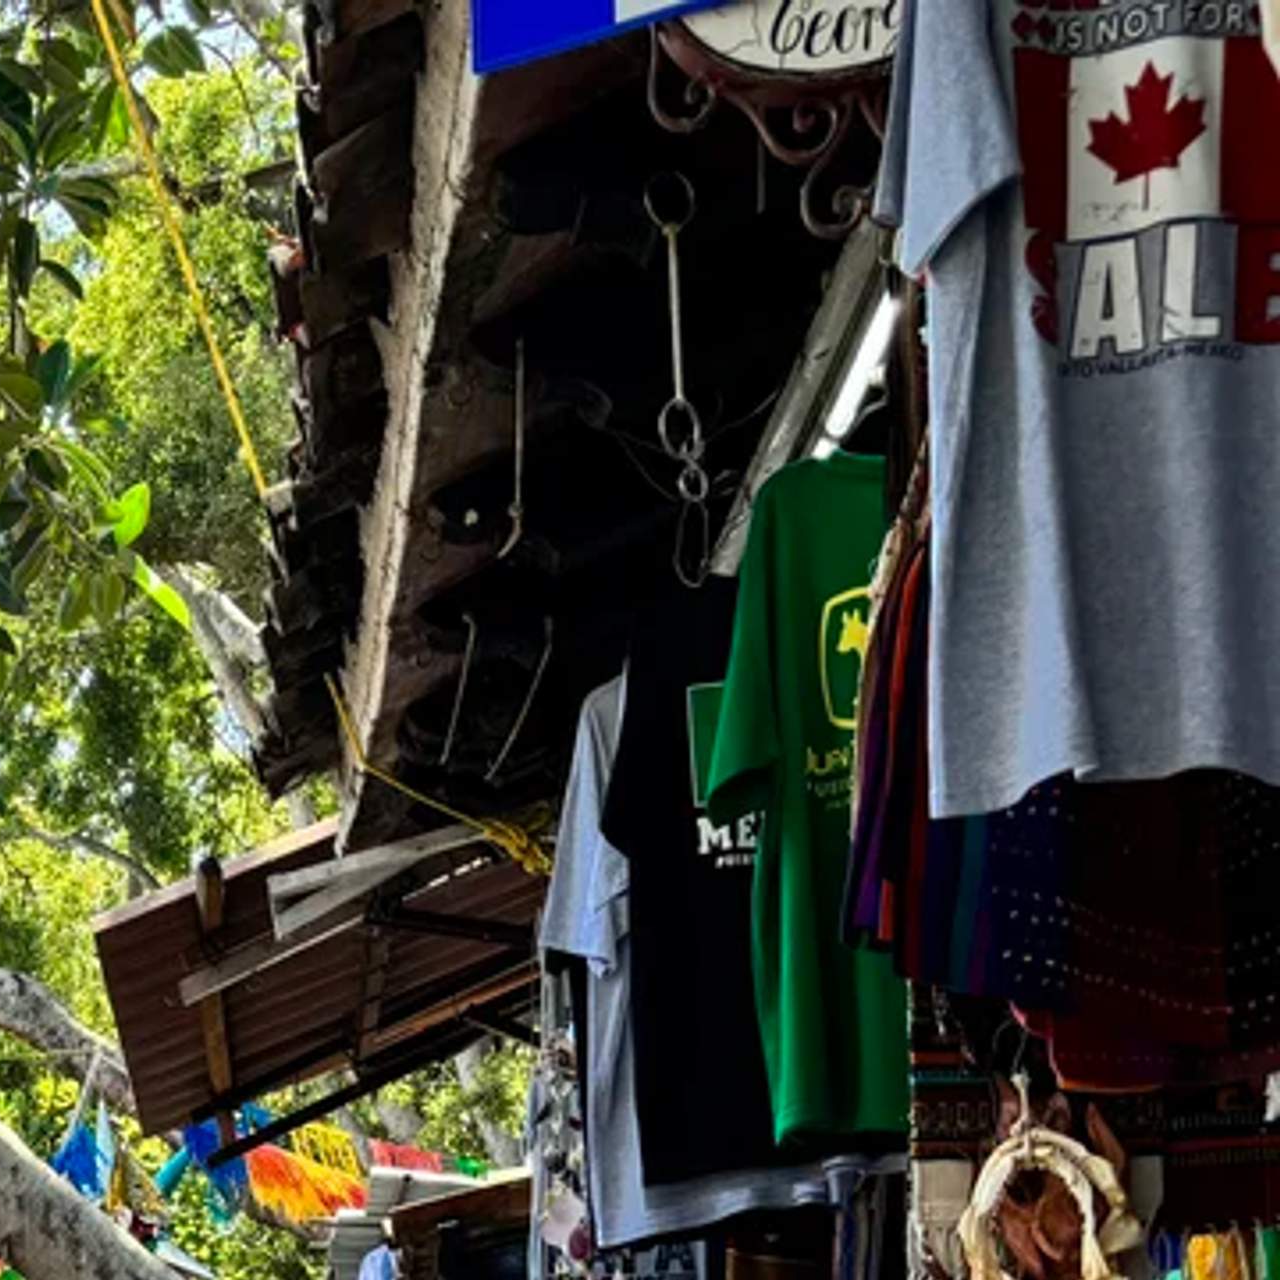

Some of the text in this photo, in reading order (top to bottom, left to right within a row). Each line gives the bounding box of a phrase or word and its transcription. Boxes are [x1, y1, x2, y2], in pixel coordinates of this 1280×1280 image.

[1054, 3, 1245, 49] IS NOT FOR
[696, 810, 767, 855] ME
